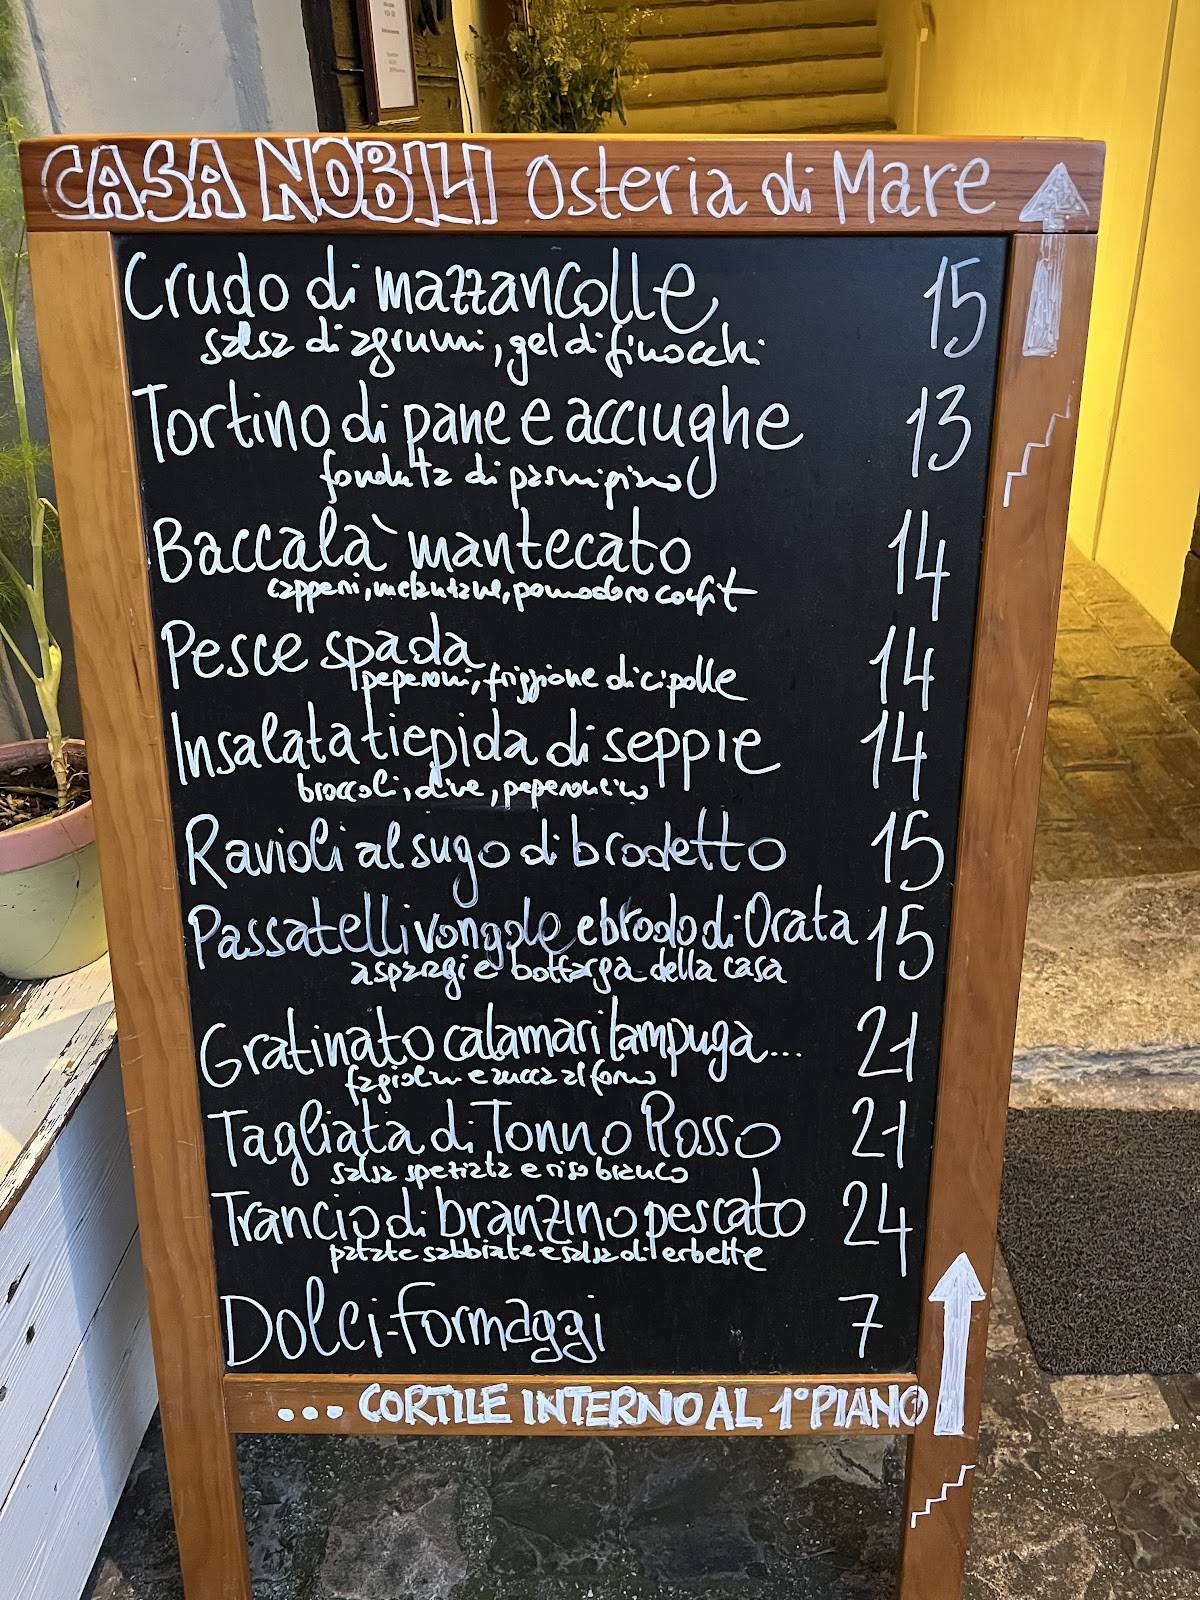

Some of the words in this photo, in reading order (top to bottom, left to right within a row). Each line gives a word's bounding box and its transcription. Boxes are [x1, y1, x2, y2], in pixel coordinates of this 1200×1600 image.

[42, 138, 246, 221] CASA
[526, 146, 748, 220] Osteria
[762, 151, 811, 215] di
[833, 149, 996, 224] Mare
[124, 252, 289, 321] Crudo
[305, 245, 360, 317] di
[376, 248, 718, 335] mazzancolle
[923, 256, 988, 359] 15
[200, 320, 295, 365] salsa
[306, 316, 342, 353] di
[507, 322, 559, 387] gel
[565, 322, 604, 354] di
[605, 322, 766, 379] finocchi
[132, 380, 330, 463] Tortino
[342, 380, 388, 443] di
[404, 402, 511, 468] pane
[521, 398, 554, 446] e
[566, 385, 804, 499] acciughe
[906, 384, 972, 478] 13
[320, 448, 453, 502] fonduta
[465, 452, 502, 486] di
[153, 505, 398, 584] Baccalà
[408, 506, 692, 575] mantecato
[887, 508, 951, 622] 14
[512, 574, 649, 613] pomodoro
[655, 566, 759, 617] confit
[161, 619, 309, 690] Pesce
[320, 611, 486, 692] spada
[483, 661, 598, 706] friggione
[606, 653, 643, 691] di
[639, 654, 749, 709] cipolle
[868, 625, 936, 712] 14
[171, 700, 361, 786] Insalata
[360, 690, 540, 790] tiepida
[546, 706, 597, 768] di
[601, 726, 781, 792] seppie
[860, 708, 928, 802] 14
[185, 813, 346, 890] Ravioli
[354, 819, 405, 870] al
[410, 832, 512, 910] sugo
[520, 818, 558, 866] di
[570, 806, 787, 872] brodetto
[870, 810, 945, 892] 15
[187, 889, 410, 971] Passatelli
[414, 895, 578, 972] vongole
[576, 913, 599, 946] e
[600, 896, 698, 948] brodo
[701, 894, 742, 950] di
[744, 884, 859, 949] Orata
[473, 958, 499, 981] e
[650, 946, 718, 983] della
[722, 956, 789, 985] casa
[866, 904, 935, 983] 15
[200, 1005, 436, 1089] Gratinato
[443, 1001, 601, 1063] calamari
[468, 1067, 488, 1084] e
[491, 1068, 558, 1087] zucca
[561, 1060, 588, 1087] al
[590, 1058, 658, 1098] forno
[856, 1005, 919, 1083] 21
[207, 1097, 425, 1187] Tagliata
[430, 1097, 475, 1154] di
[470, 1098, 633, 1156] Tonno
[640, 1089, 783, 1160] Rosso
[330, 1155, 399, 1185] salsa
[520, 1162, 543, 1180] e
[545, 1158, 590, 1182] riso
[595, 1156, 690, 1184] bianco
[851, 1096, 907, 1169] 21
[211, 1190, 380, 1247] Trancio
[385, 1186, 428, 1240] di
[435, 1186, 639, 1245] branzino
[643, 1166, 807, 1262] pescato
[330, 1237, 419, 1275] patate
[422, 1233, 537, 1263] sabbiate
[538, 1247, 562, 1262] e
[560, 1240, 619, 1265] salsa
[660, 1236, 768, 1272] erbette
[842, 1180, 914, 1278] 24
[838, 1293, 884, 1359] 7
[358, 1382, 513, 1427] CORTILE
[521, 1384, 704, 1428] INTERNO
[704, 1384, 763, 1431] AL
